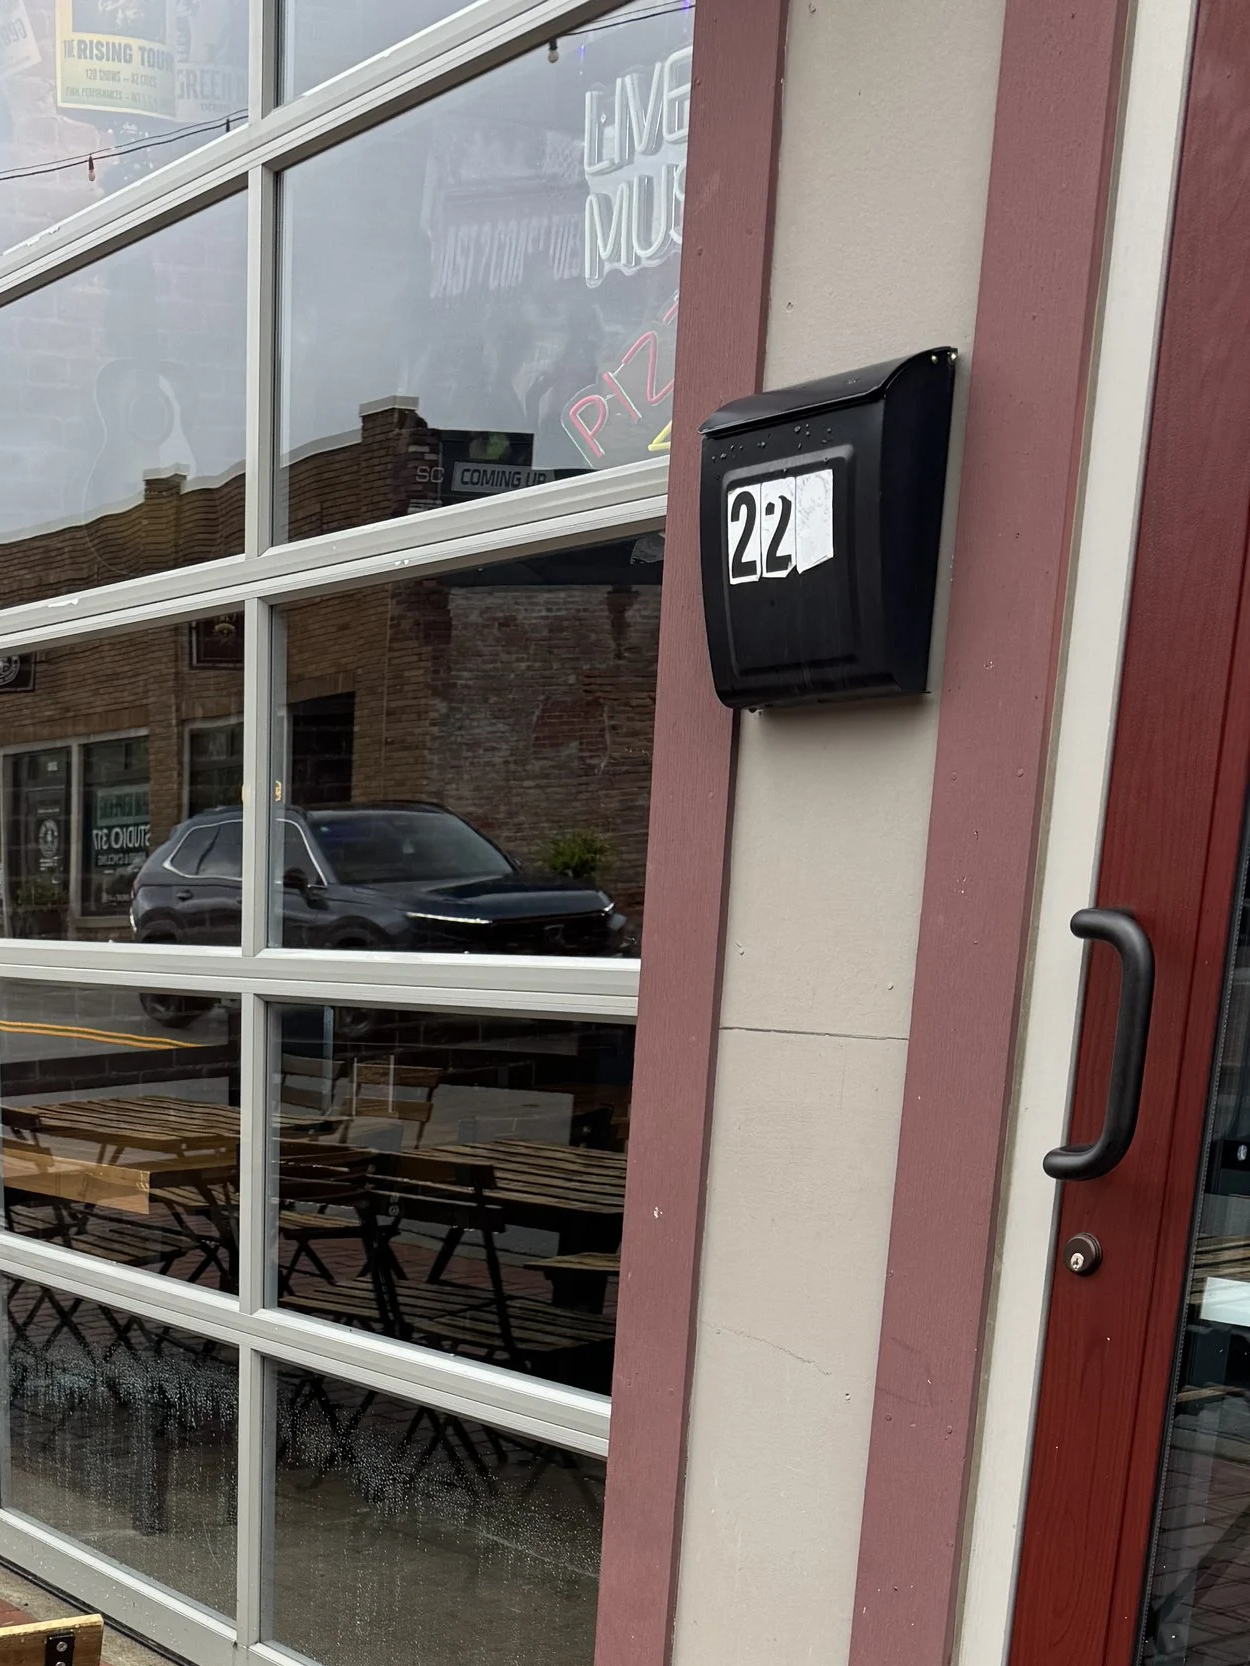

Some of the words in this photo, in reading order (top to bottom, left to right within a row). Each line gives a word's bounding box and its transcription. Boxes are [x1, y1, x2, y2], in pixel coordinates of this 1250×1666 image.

[76, 39, 134, 64] RISING
[138, 46, 176, 73] TOUR
[585, 46, 693, 174] LIVE
[461, 468, 522, 488] COMING
